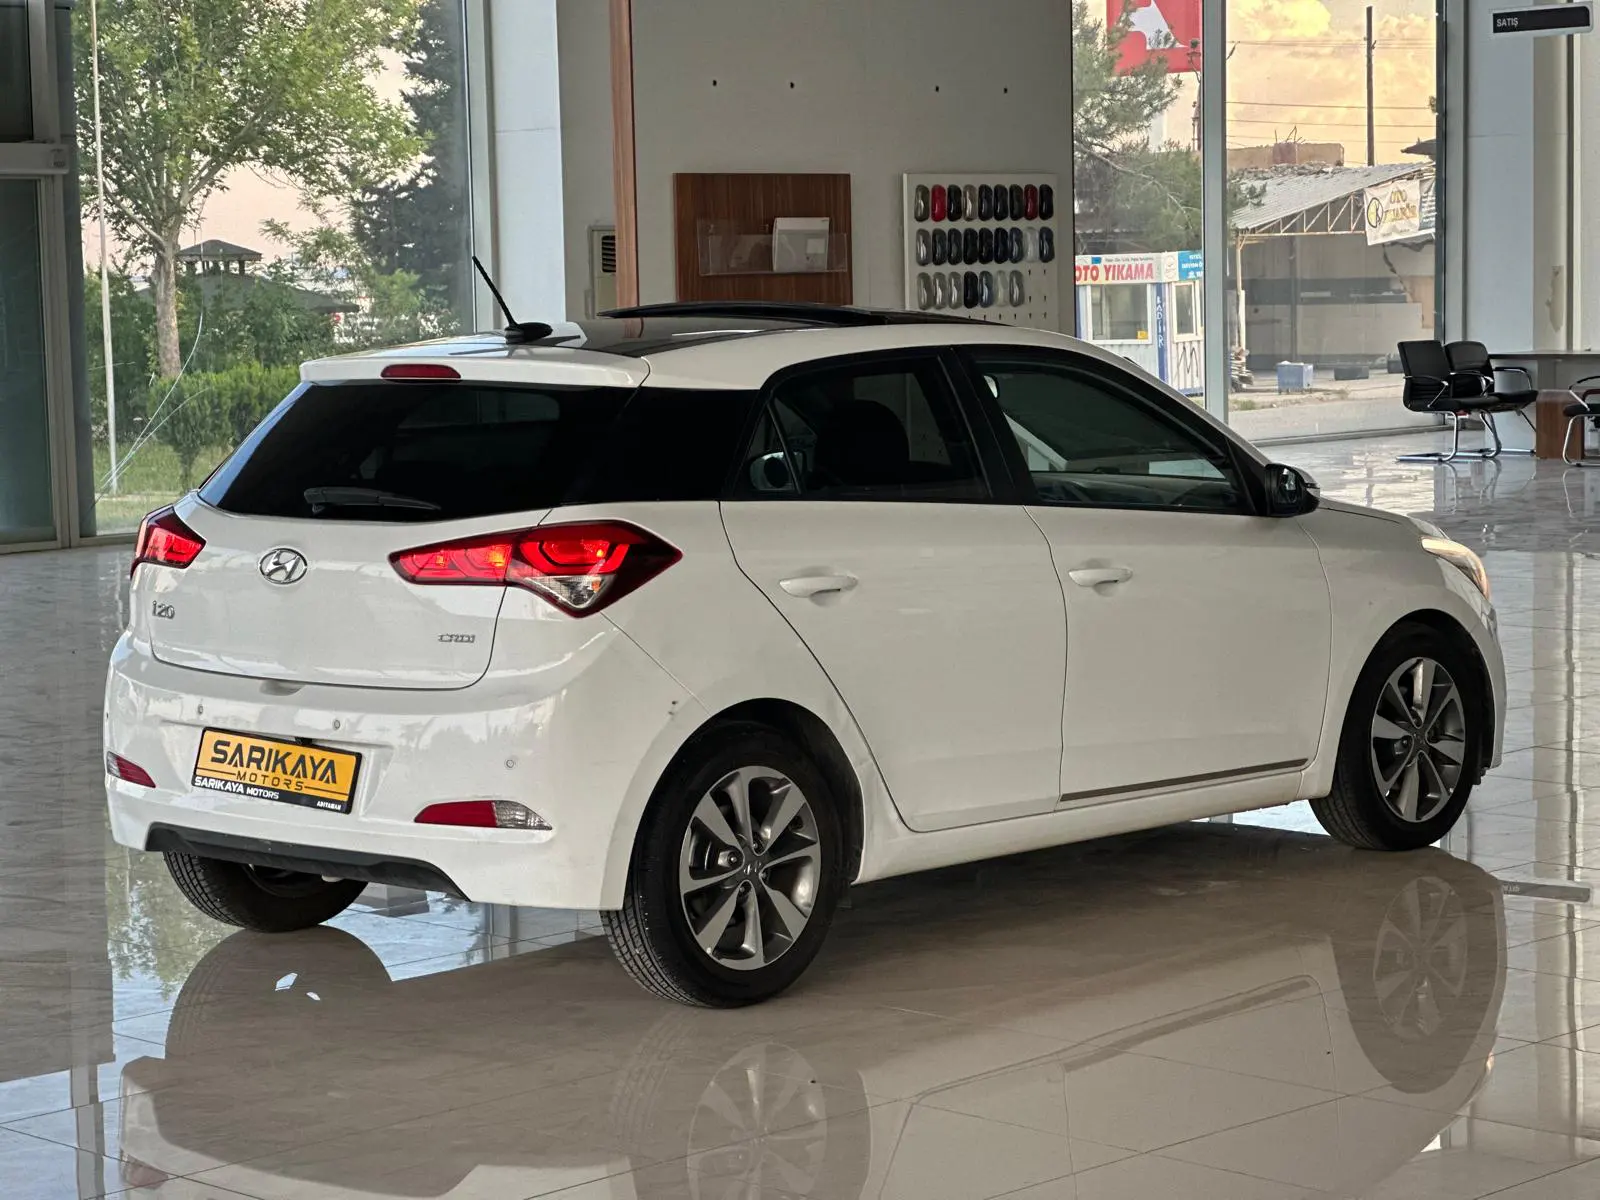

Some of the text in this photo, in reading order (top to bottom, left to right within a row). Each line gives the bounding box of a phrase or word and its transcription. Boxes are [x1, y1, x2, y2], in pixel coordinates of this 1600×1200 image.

[1496, 17, 1519, 28] SATIŞ
[1104, 263, 1154, 281] YIKAMA
[152, 600, 175, 619] i20
[210, 740, 337, 784] SARIKAYA
[194, 776, 280, 799] SARIKAYA MOTORS
[236, 770, 304, 791] MOTORS
